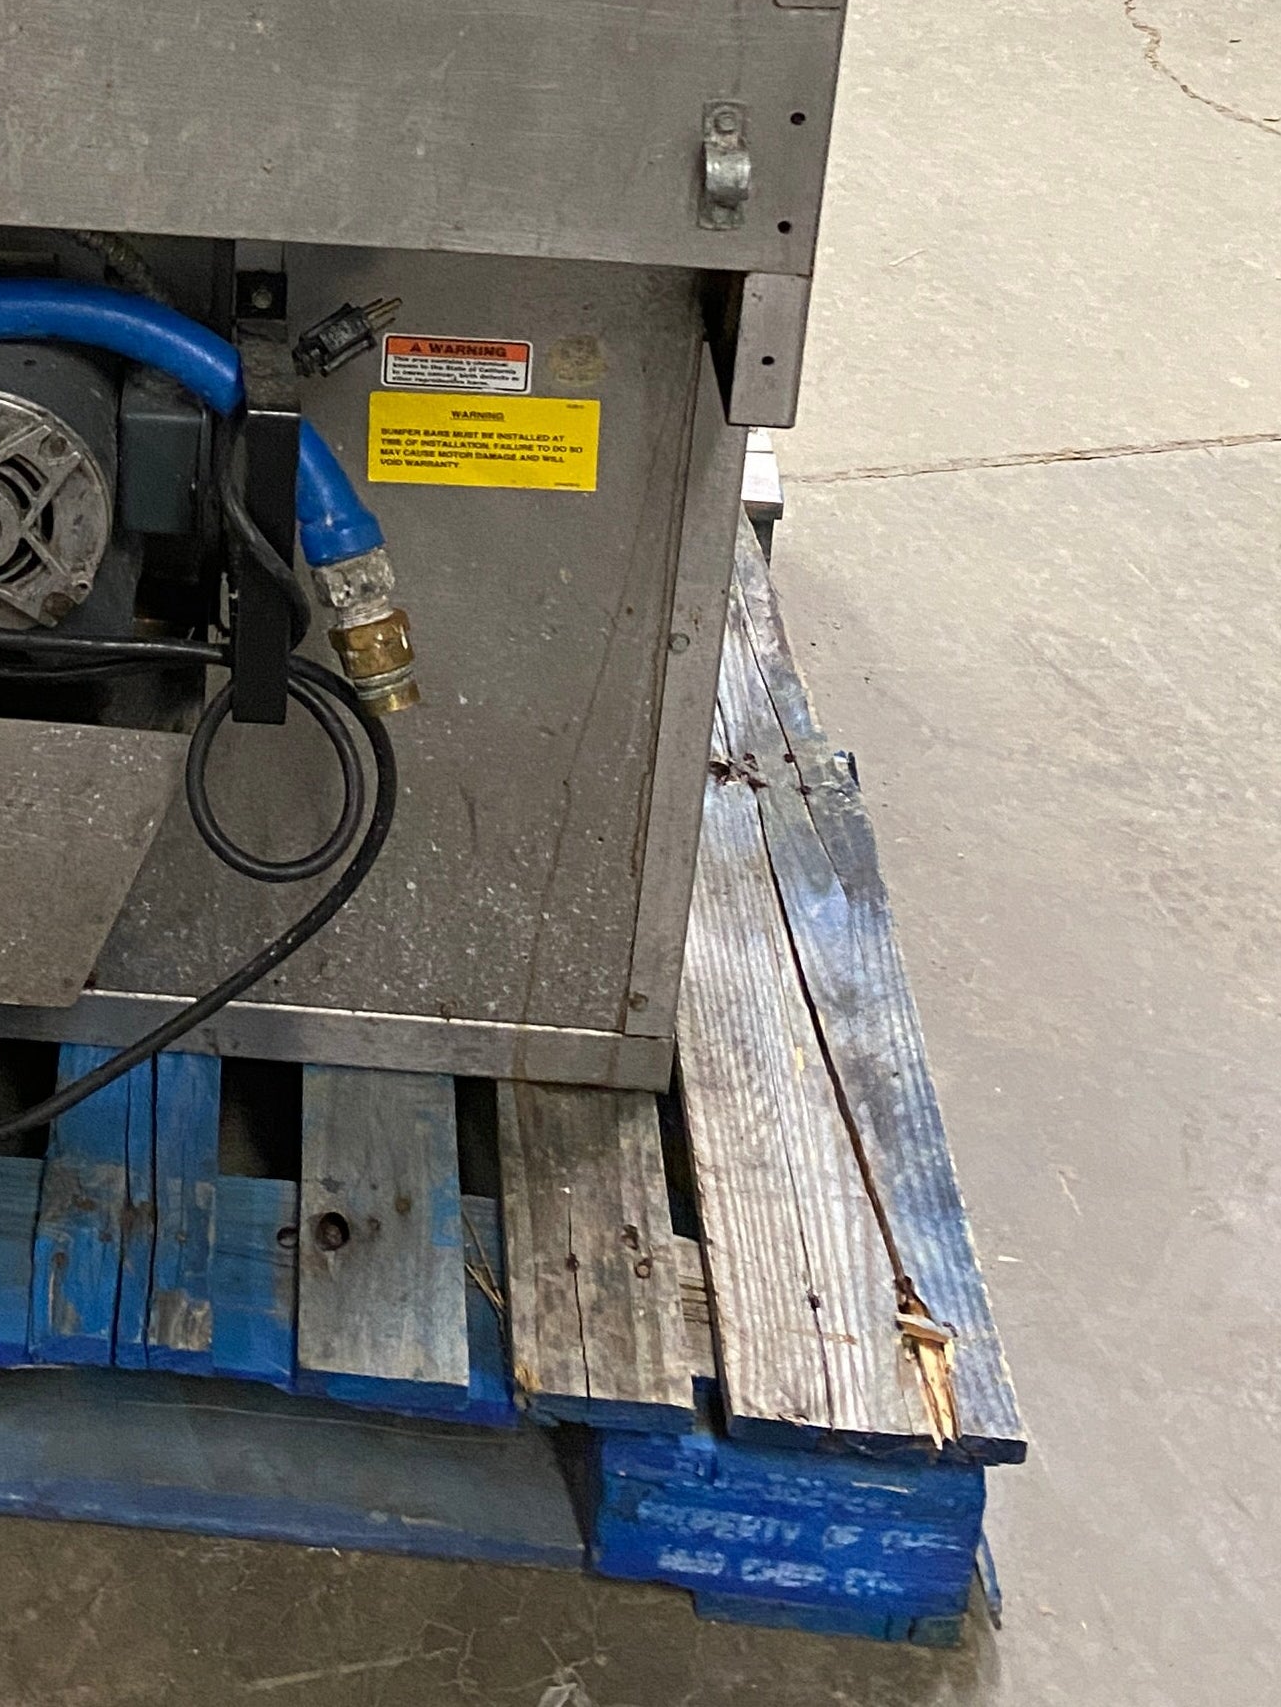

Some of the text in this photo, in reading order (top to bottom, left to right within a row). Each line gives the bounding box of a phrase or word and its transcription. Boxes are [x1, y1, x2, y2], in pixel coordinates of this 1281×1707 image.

[429, 343, 507, 357] WARNING
[450, 411, 504, 422] WARNING
[381, 428, 421, 436] BUMPER
[453, 430, 479, 438] MUST
[497, 433, 550, 442] INSTALLED
[493, 443, 534, 452] FAILURE
[380, 458, 403, 466] VOID
[403, 449, 435, 457] CAUSE
[438, 450, 473, 459] MOTOR
[475, 452, 517, 461] DAMAGE
[519, 454, 540, 462] AND
[542, 455, 565, 463] WILL
